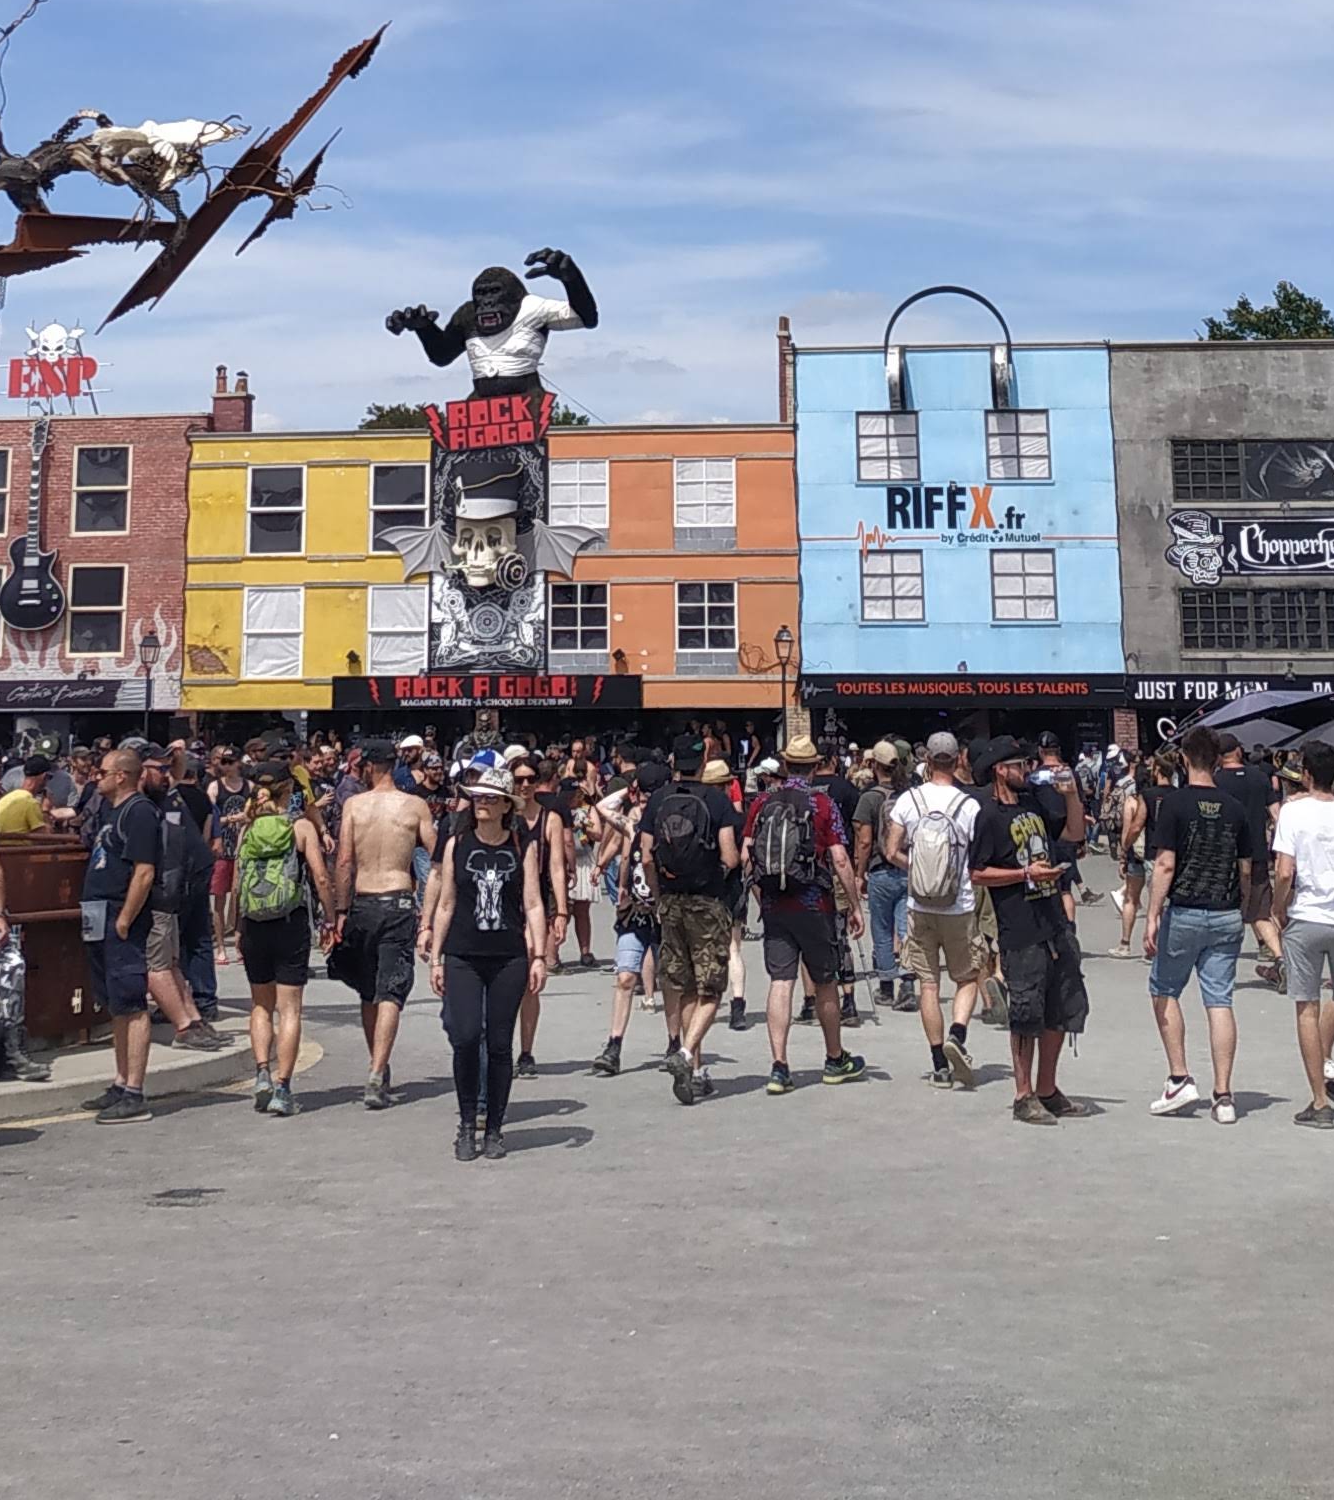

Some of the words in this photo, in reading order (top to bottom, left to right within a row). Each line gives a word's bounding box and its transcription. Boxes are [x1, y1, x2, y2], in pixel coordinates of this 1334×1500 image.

[8, 356, 97, 398] ESP
[447, 396, 533, 429] ROCK
[941, 533, 954, 545] by
[957, 532, 989, 543] Crédit
[1005, 532, 1041, 543] Mutuel
[395, 677, 465, 698] ROCK
[473, 677, 490, 698] A
[836, 682, 883, 695] TOUTES
[885, 682, 906, 695] LES
[907, 682, 977, 696] MUSIQUES,
[978, 682, 1006, 695] TOUS
[1013, 682, 1035, 695] LES
[1036, 682, 1089, 695] TALENTS
[1134, 681, 1177, 700] JUST
[1184, 681, 1218, 700] FOR
[400, 698, 439, 707] MAGASIN
[439, 698, 451, 707] DE
